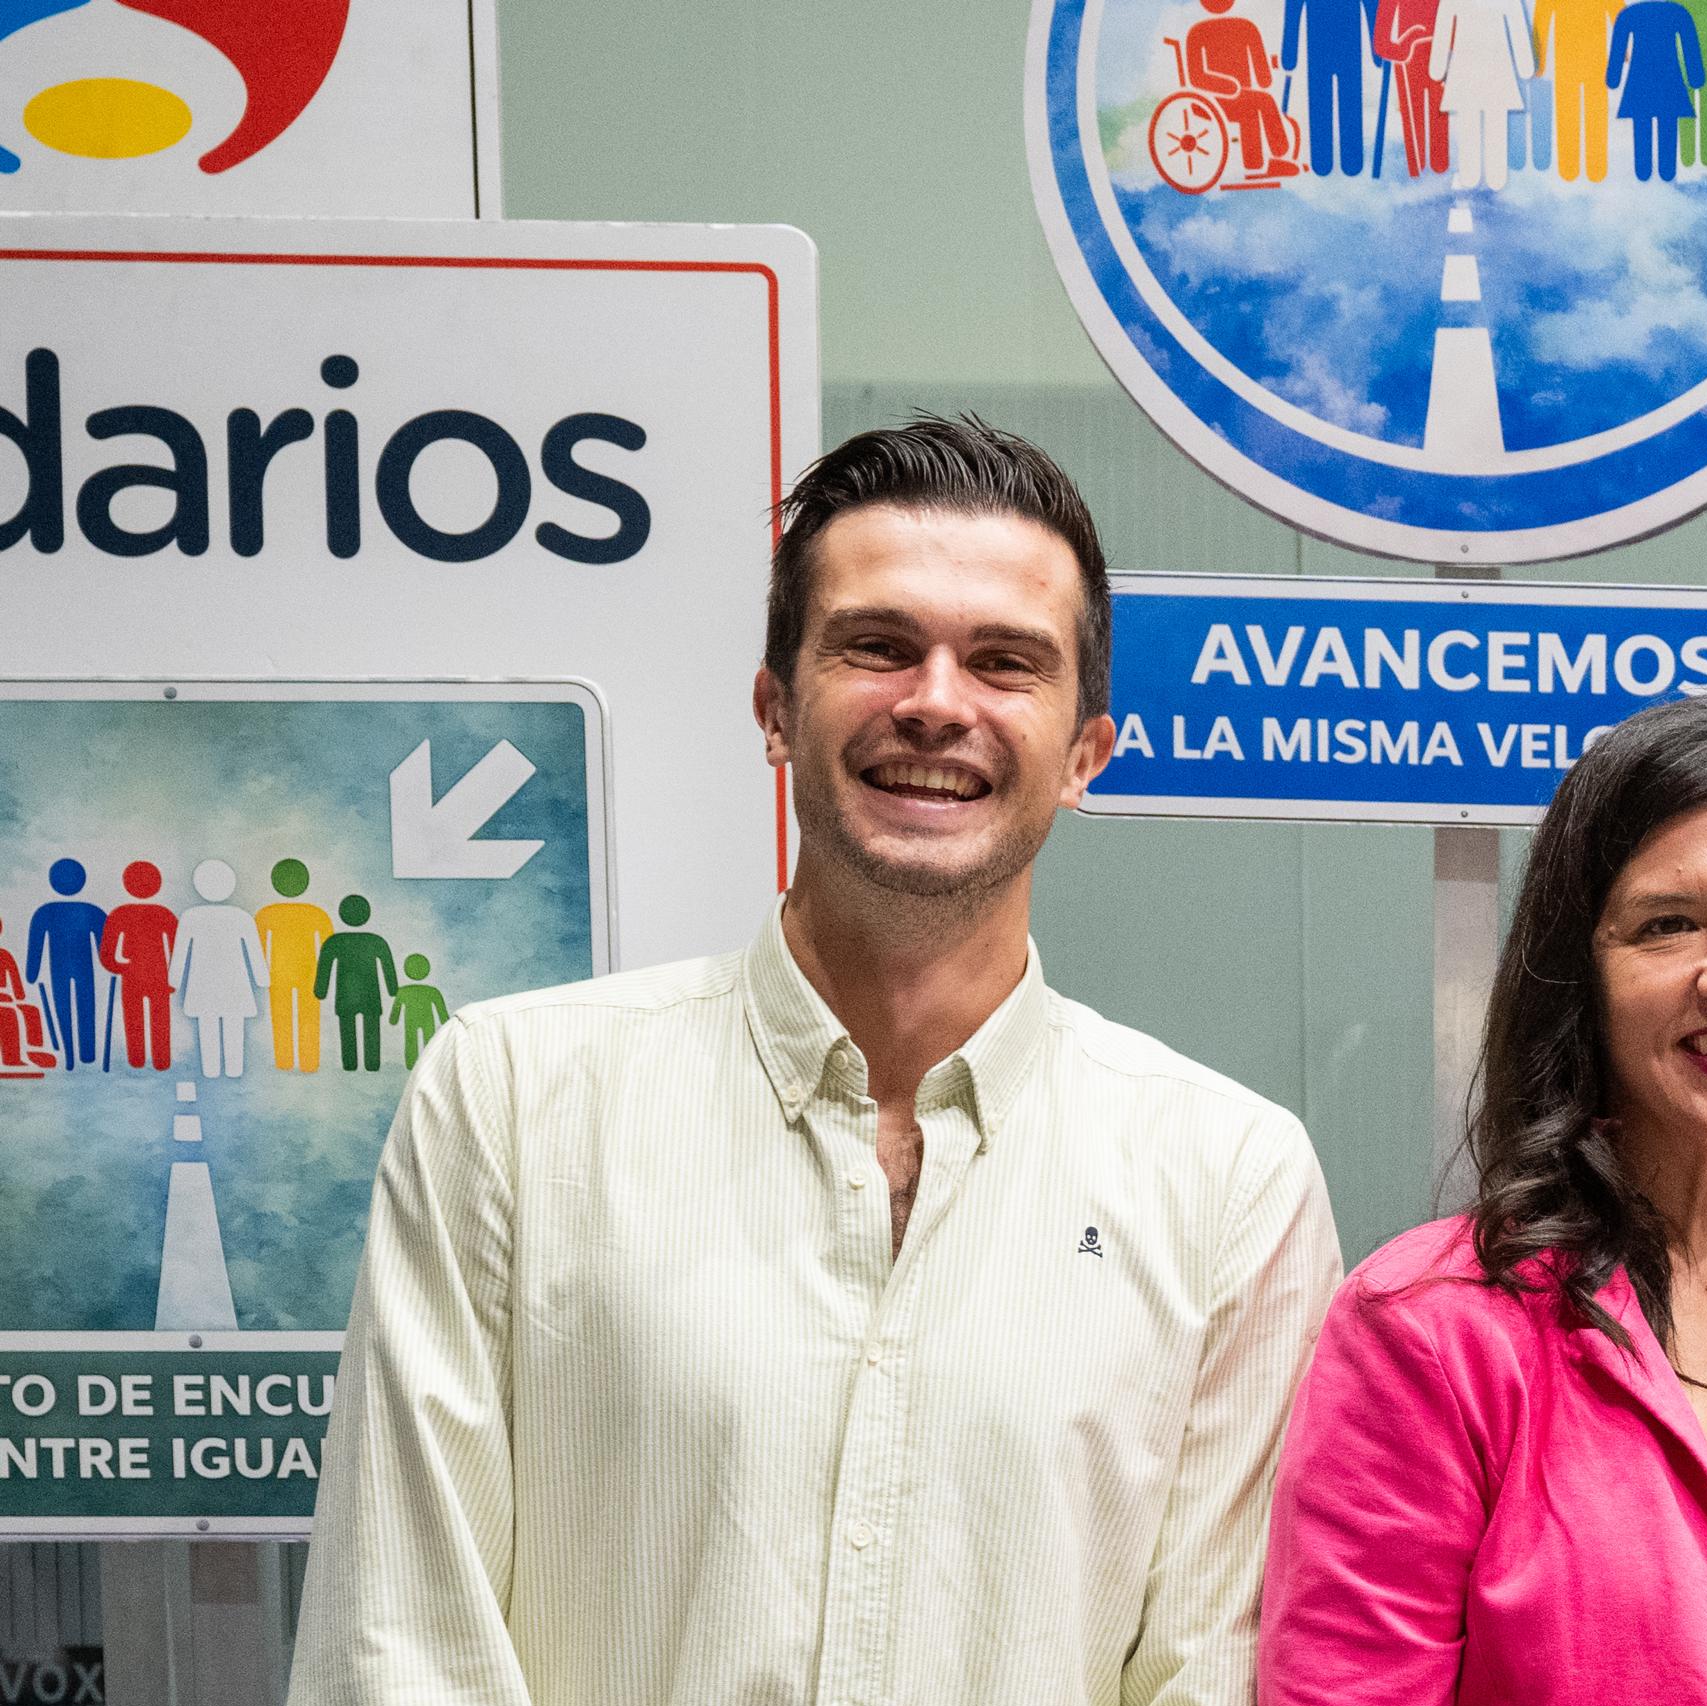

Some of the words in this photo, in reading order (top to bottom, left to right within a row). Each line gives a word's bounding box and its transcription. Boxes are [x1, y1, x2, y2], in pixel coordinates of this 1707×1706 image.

[1113, 713, 1155, 758] A
[1172, 715, 1245, 760] LA
[1262, 717, 1464, 767] MISMA
[77, 1374, 154, 1416] DE
[0, 1437, 151, 1479] NTRE
[172, 1437, 328, 1480] IGUA
